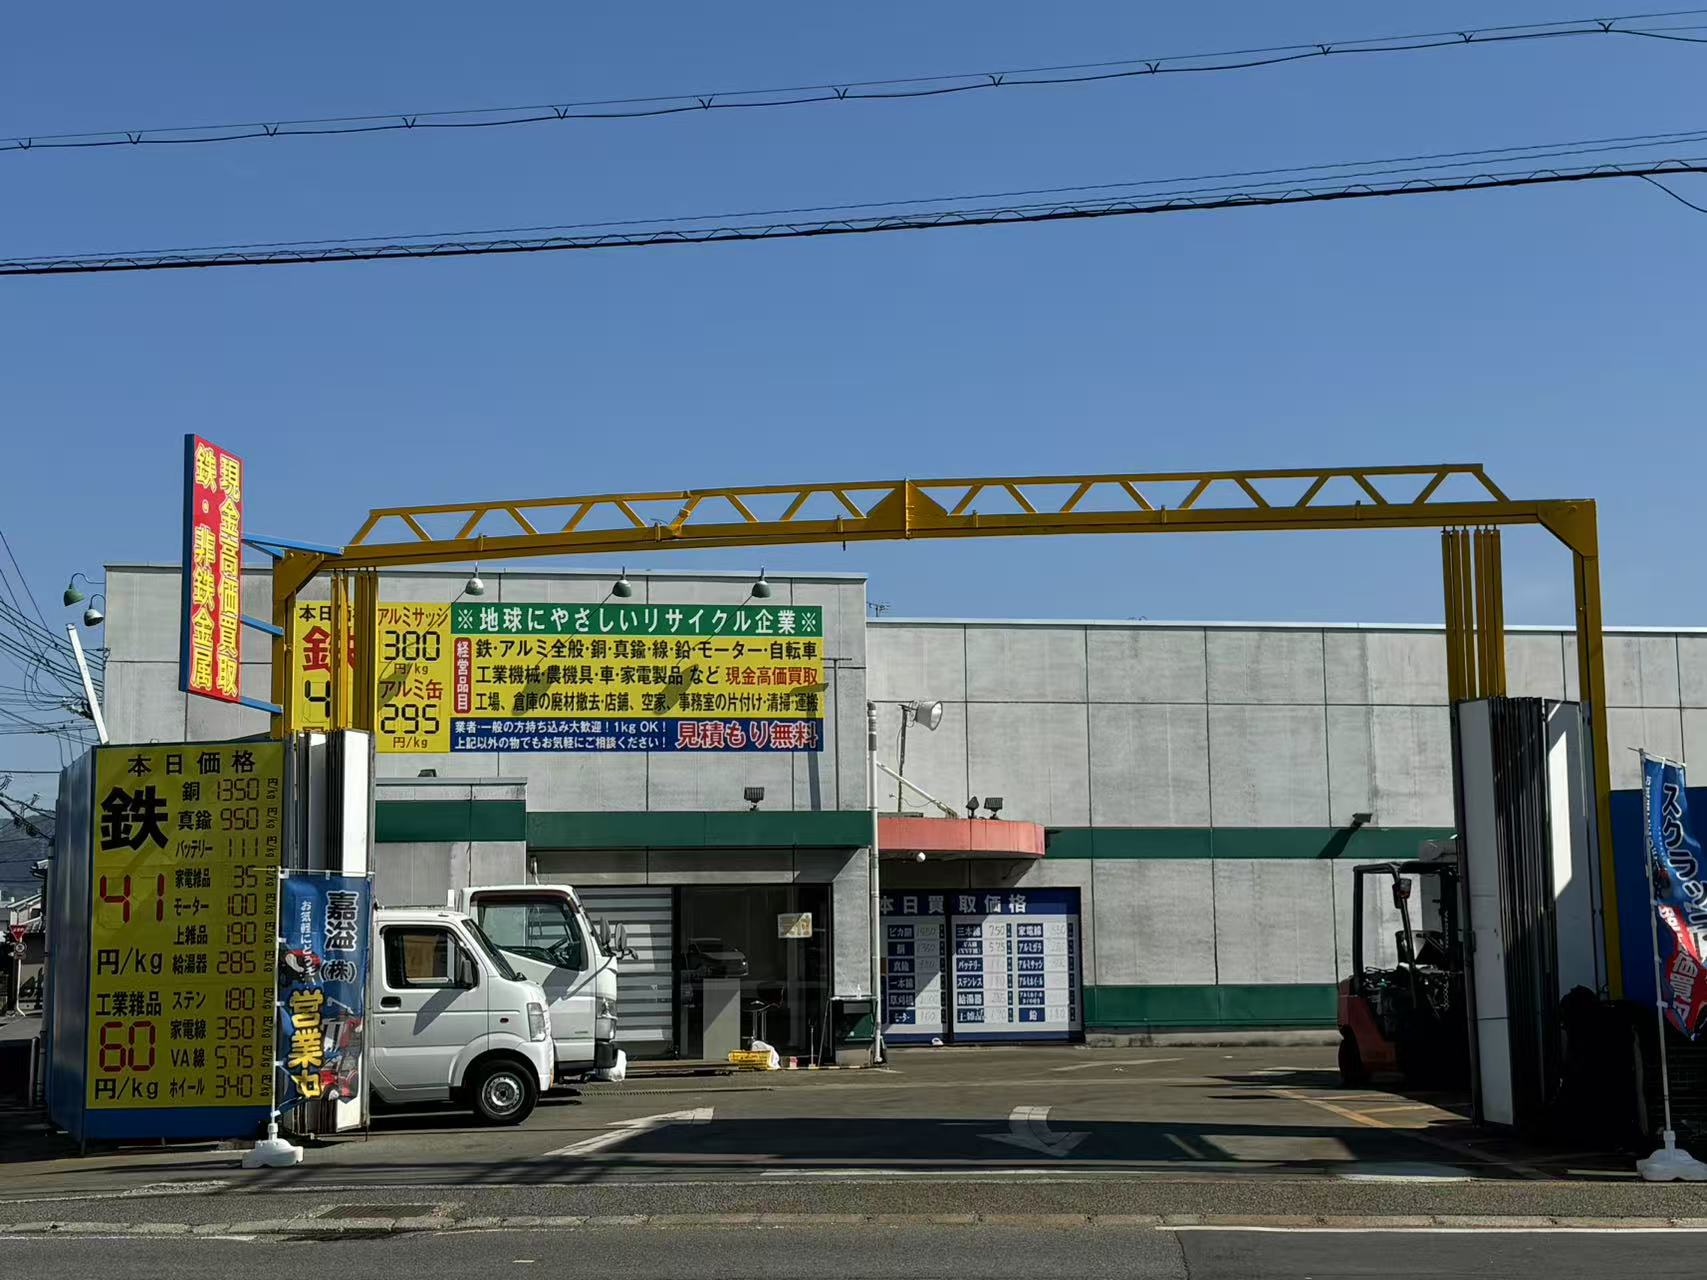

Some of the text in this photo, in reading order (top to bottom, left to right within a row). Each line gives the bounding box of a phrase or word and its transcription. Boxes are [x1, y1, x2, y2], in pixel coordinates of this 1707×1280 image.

[217, 453, 240, 697] 現金高価買取
[378, 607, 448, 627] アルミサッシ
[384, 631, 440, 661] 300
[394, 663, 428, 675] 円/kg
[457, 640, 470, 711] 経営品目
[378, 679, 443, 700] アルミ缶
[381, 704, 440, 734] 295
[393, 736, 428, 748] 円/kg
[676, 720, 816, 749] 見積もり無料
[128, 750, 256, 777] 本日価格
[182, 782, 200, 801] 銅
[217, 778, 259, 801] 1350
[101, 786, 168, 851] 鉄
[178, 810, 212, 830] 真鍮
[221, 808, 258, 830] 950
[176, 839, 212, 858] バッテリー
[229, 838, 258, 858] 111
[234, 866, 258, 888] 35
[100, 874, 165, 922] 41
[174, 897, 208, 916] モーター
[228, 894, 256, 916] 100
[227, 922, 256, 945] 190
[97, 948, 162, 976] 円/kg
[172, 954, 208, 974] 給湯器
[217, 951, 256, 974] 285
[958, 978, 982, 986] ステンレス
[172, 991, 206, 1010] ステン
[225, 988, 255, 1010] 180
[170, 1019, 206, 1040] 家電線
[216, 1016, 254, 1040] 350
[99, 1020, 156, 1072] 60
[288, 988, 323, 1099] 営業中
[215, 1046, 254, 1069] 575
[94, 1077, 158, 1101] 円/kg
[170, 1077, 206, 1098] ホイール
[216, 1075, 253, 1098] 340
